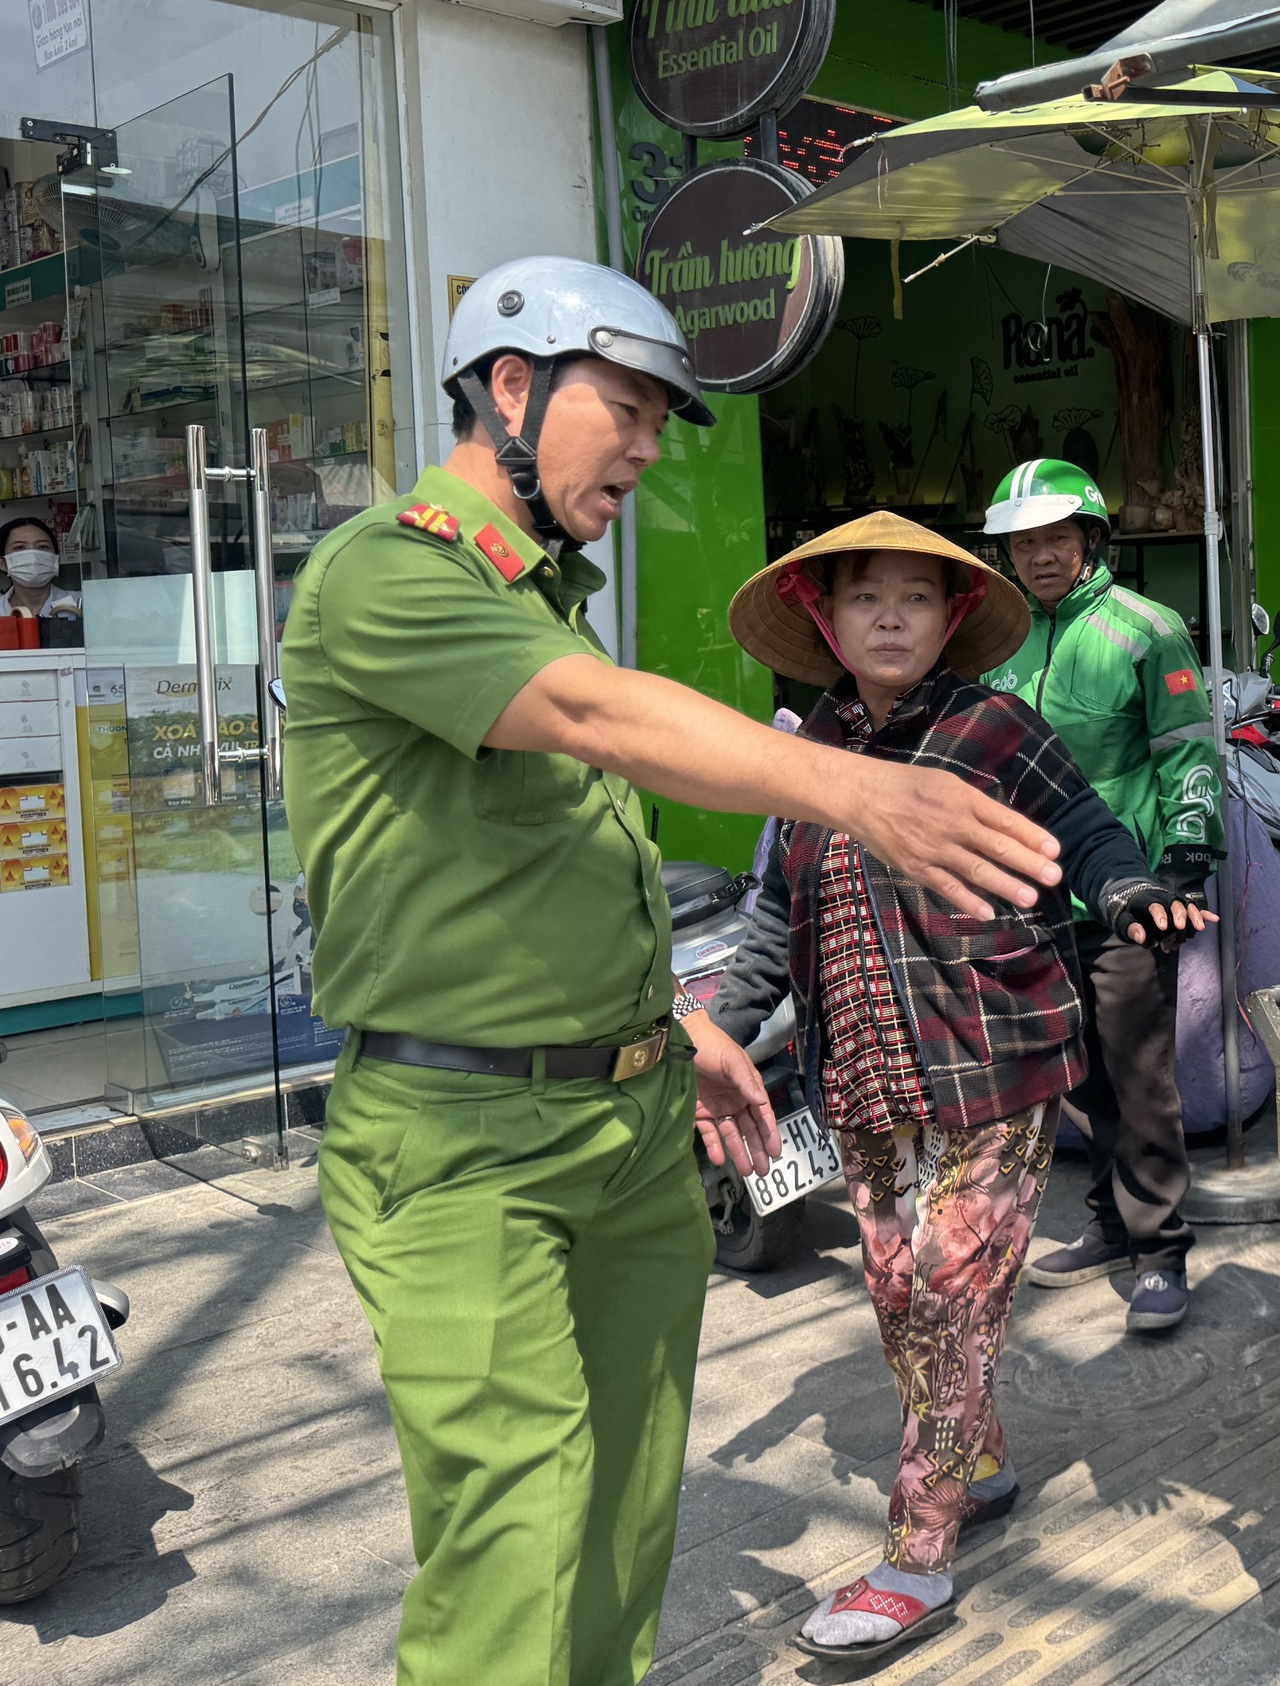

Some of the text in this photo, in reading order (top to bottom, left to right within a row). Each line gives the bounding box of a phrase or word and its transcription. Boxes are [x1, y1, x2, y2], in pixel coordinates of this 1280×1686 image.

[658, 21, 777, 79] Essential Oil
[645, 238, 801, 297] Trầm hương
[674, 289, 776, 339] Agarwood
[153, 743, 174, 759] CẢ
[178, 744, 201, 758] NH
[754, 1142, 839, 1206] 882.43
[0, 1284, 76, 1354] -AA
